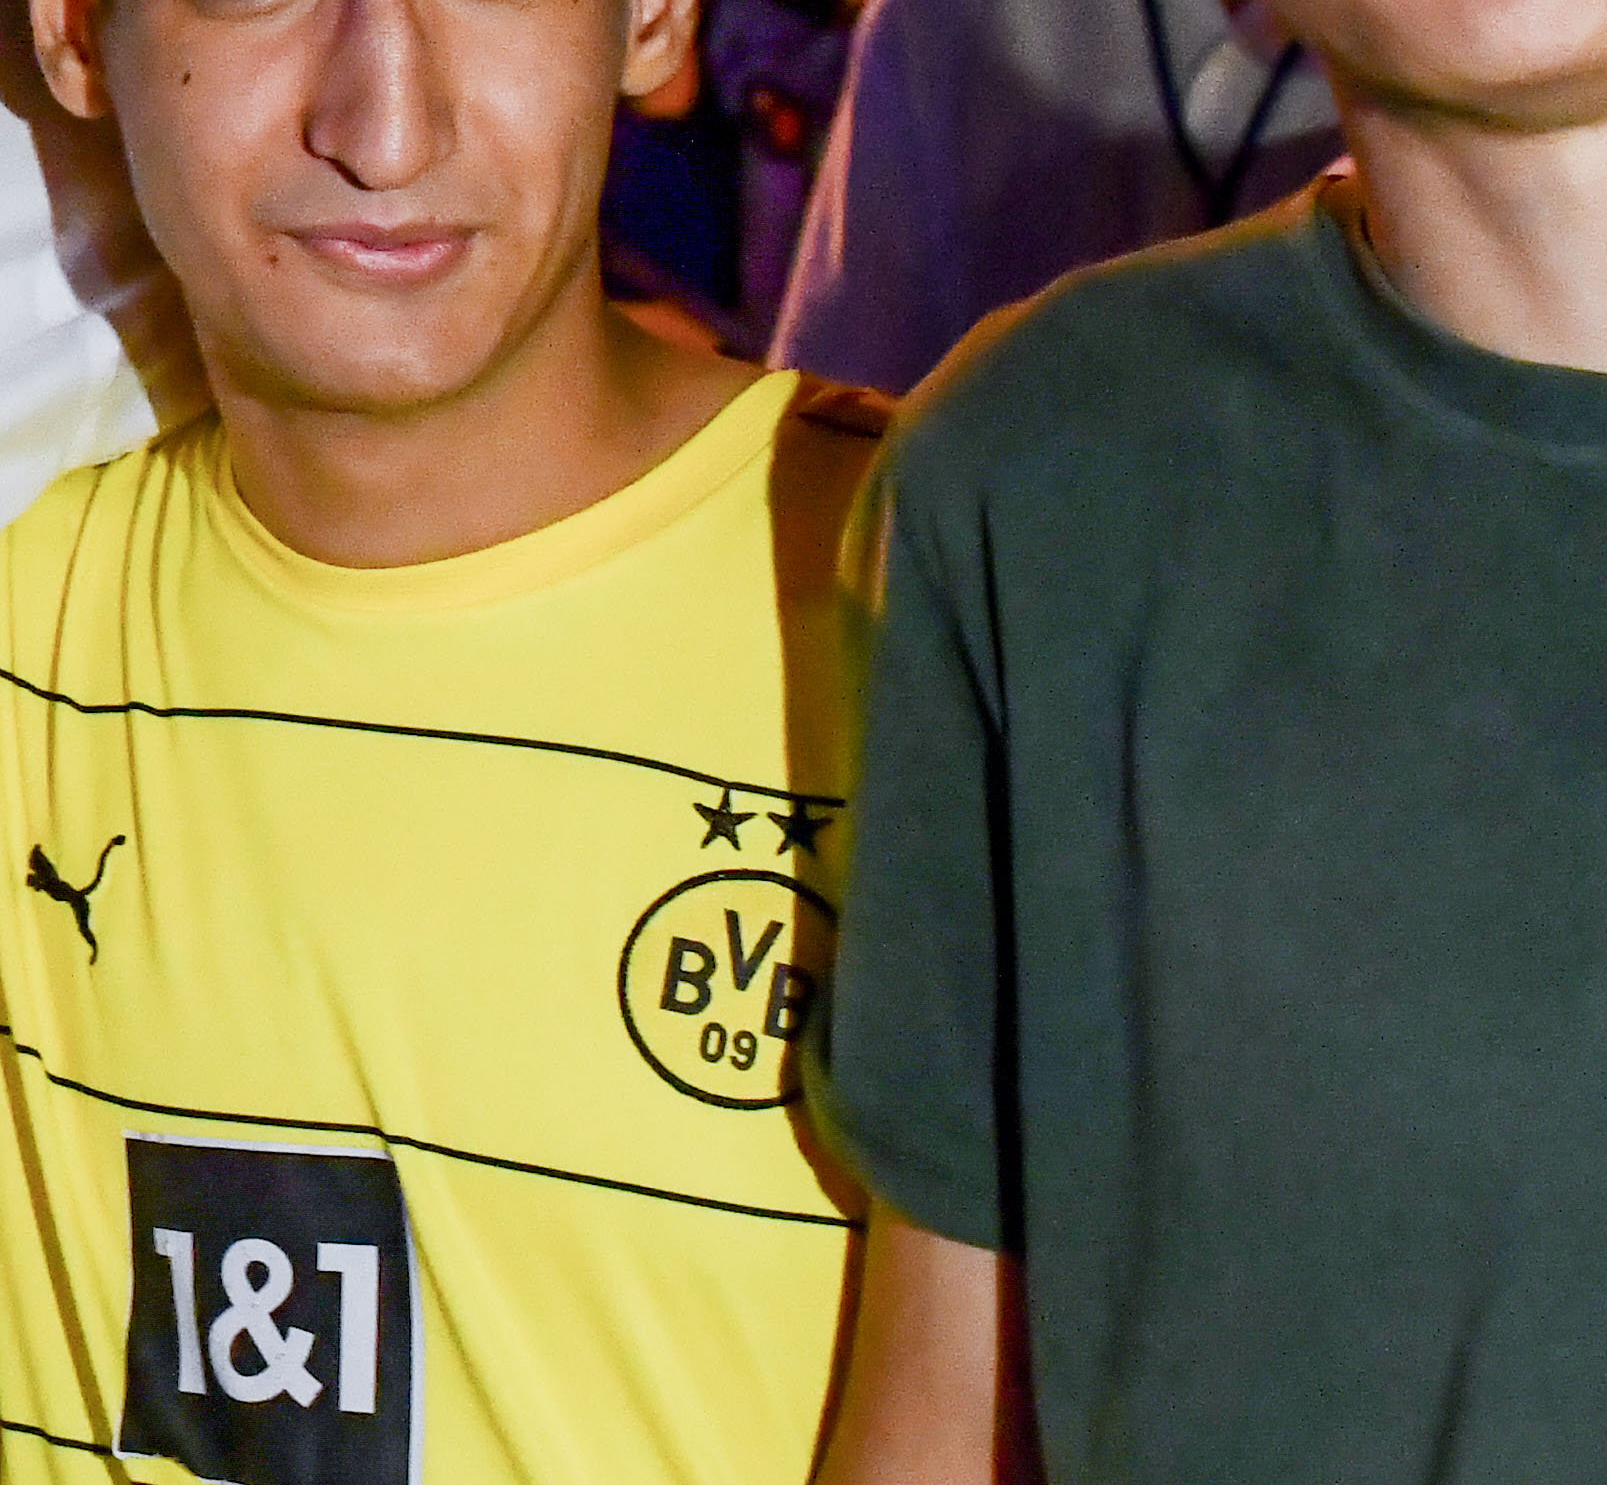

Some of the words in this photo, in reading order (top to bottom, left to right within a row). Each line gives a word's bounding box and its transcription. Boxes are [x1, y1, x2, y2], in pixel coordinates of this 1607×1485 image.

[659, 908, 817, 1041] BVB
[699, 1021, 758, 1071] 09
[152, 1226, 380, 1415] 1&1
